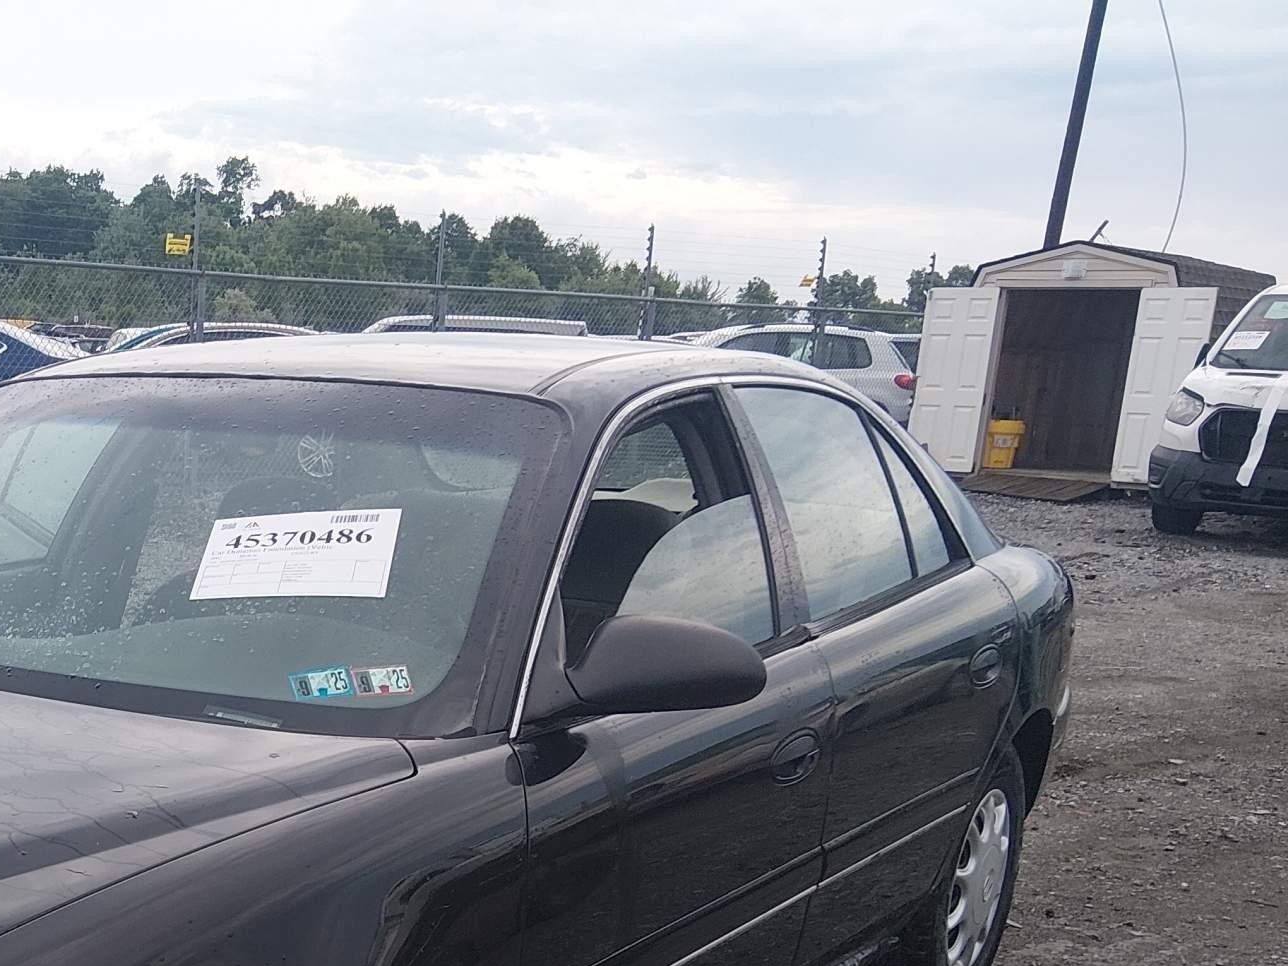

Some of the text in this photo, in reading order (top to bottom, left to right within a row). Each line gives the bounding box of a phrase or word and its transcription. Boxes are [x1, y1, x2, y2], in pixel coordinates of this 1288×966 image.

[225, 527, 375, 549] 45370486
[331, 671, 348, 691] 25
[393, 669, 409, 689] 25
